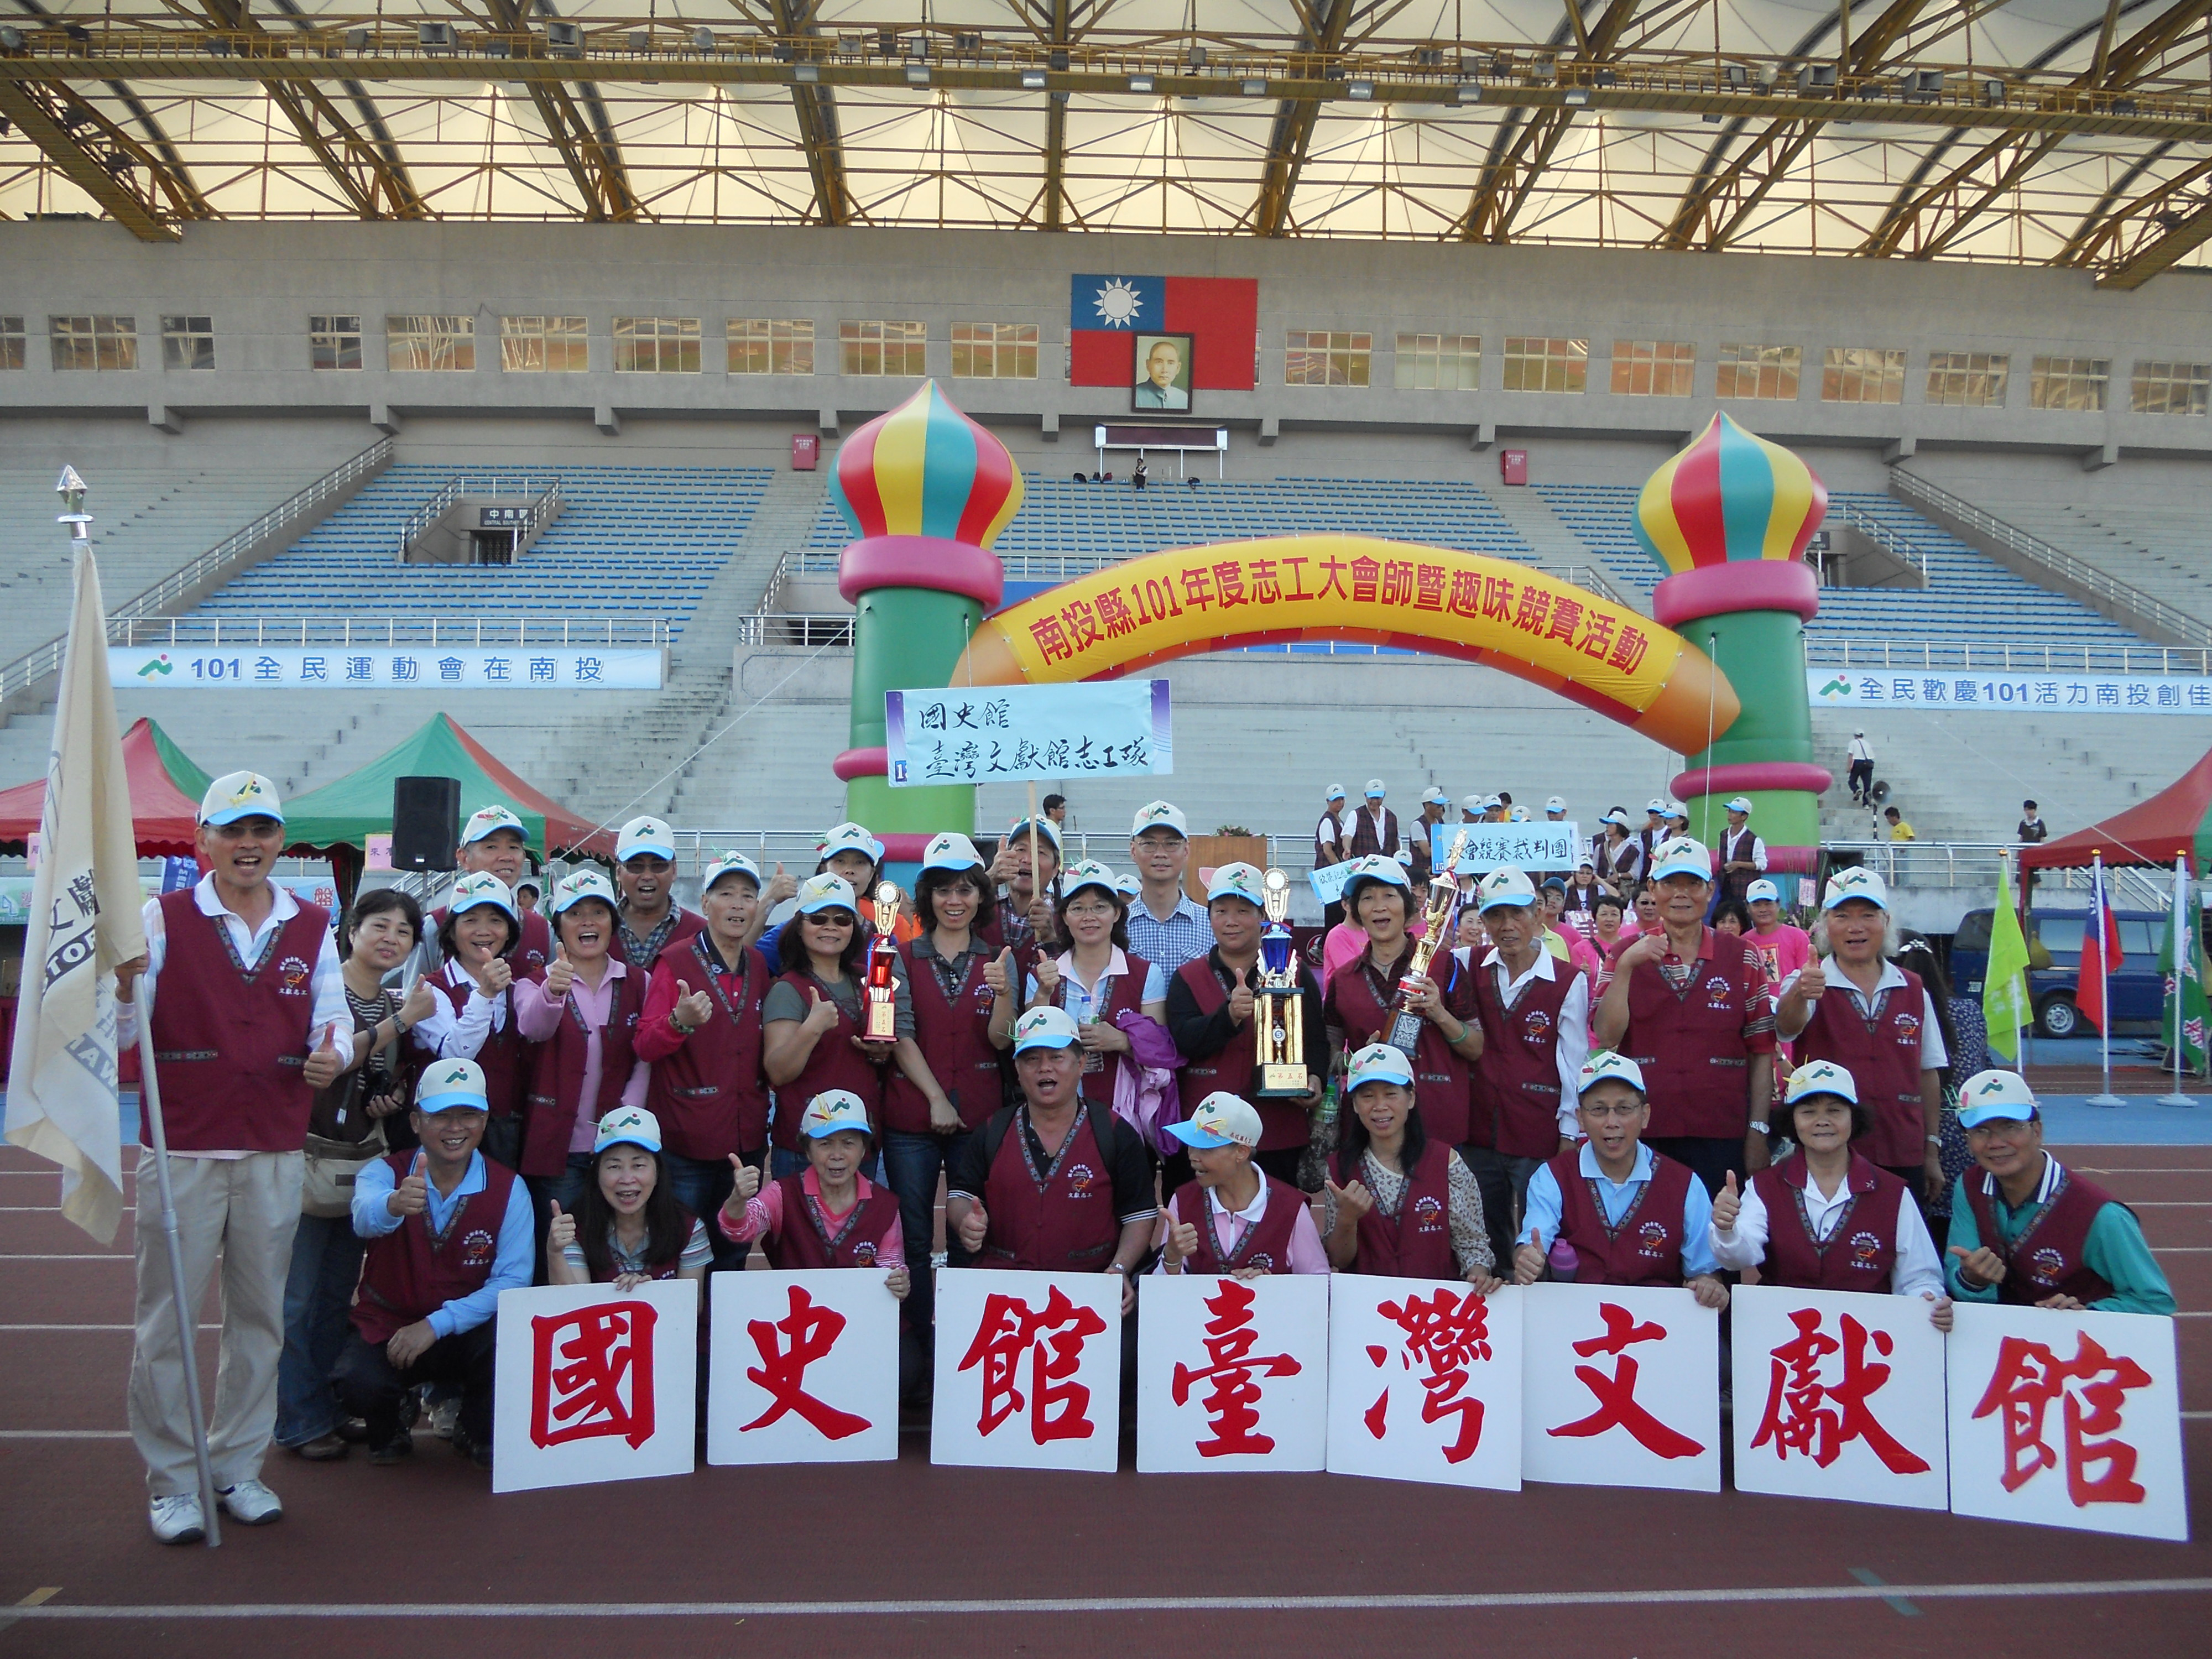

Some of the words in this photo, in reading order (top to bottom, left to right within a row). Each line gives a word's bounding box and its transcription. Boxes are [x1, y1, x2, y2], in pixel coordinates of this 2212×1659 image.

[489, 509, 528, 519] 中南區
[1029, 555, 1648, 675] 南投縣101年度志工大會師暨趣味競賽活動
[919, 698, 1010, 731] 國史館
[897, 764, 907, 779] 1
[926, 734, 1149, 779] 臺灣文獻館志工隊
[531, 1303, 656, 1448] 國
[739, 1285, 872, 1440] 史
[959, 1287, 1105, 1444] 館
[1173, 1281, 1301, 1457] 臺
[1366, 1290, 1490, 1462] 灣
[1547, 1303, 1705, 1459] 文
[1751, 1308, 1931, 1474] 獻
[1973, 1330, 2152, 1507] 館
